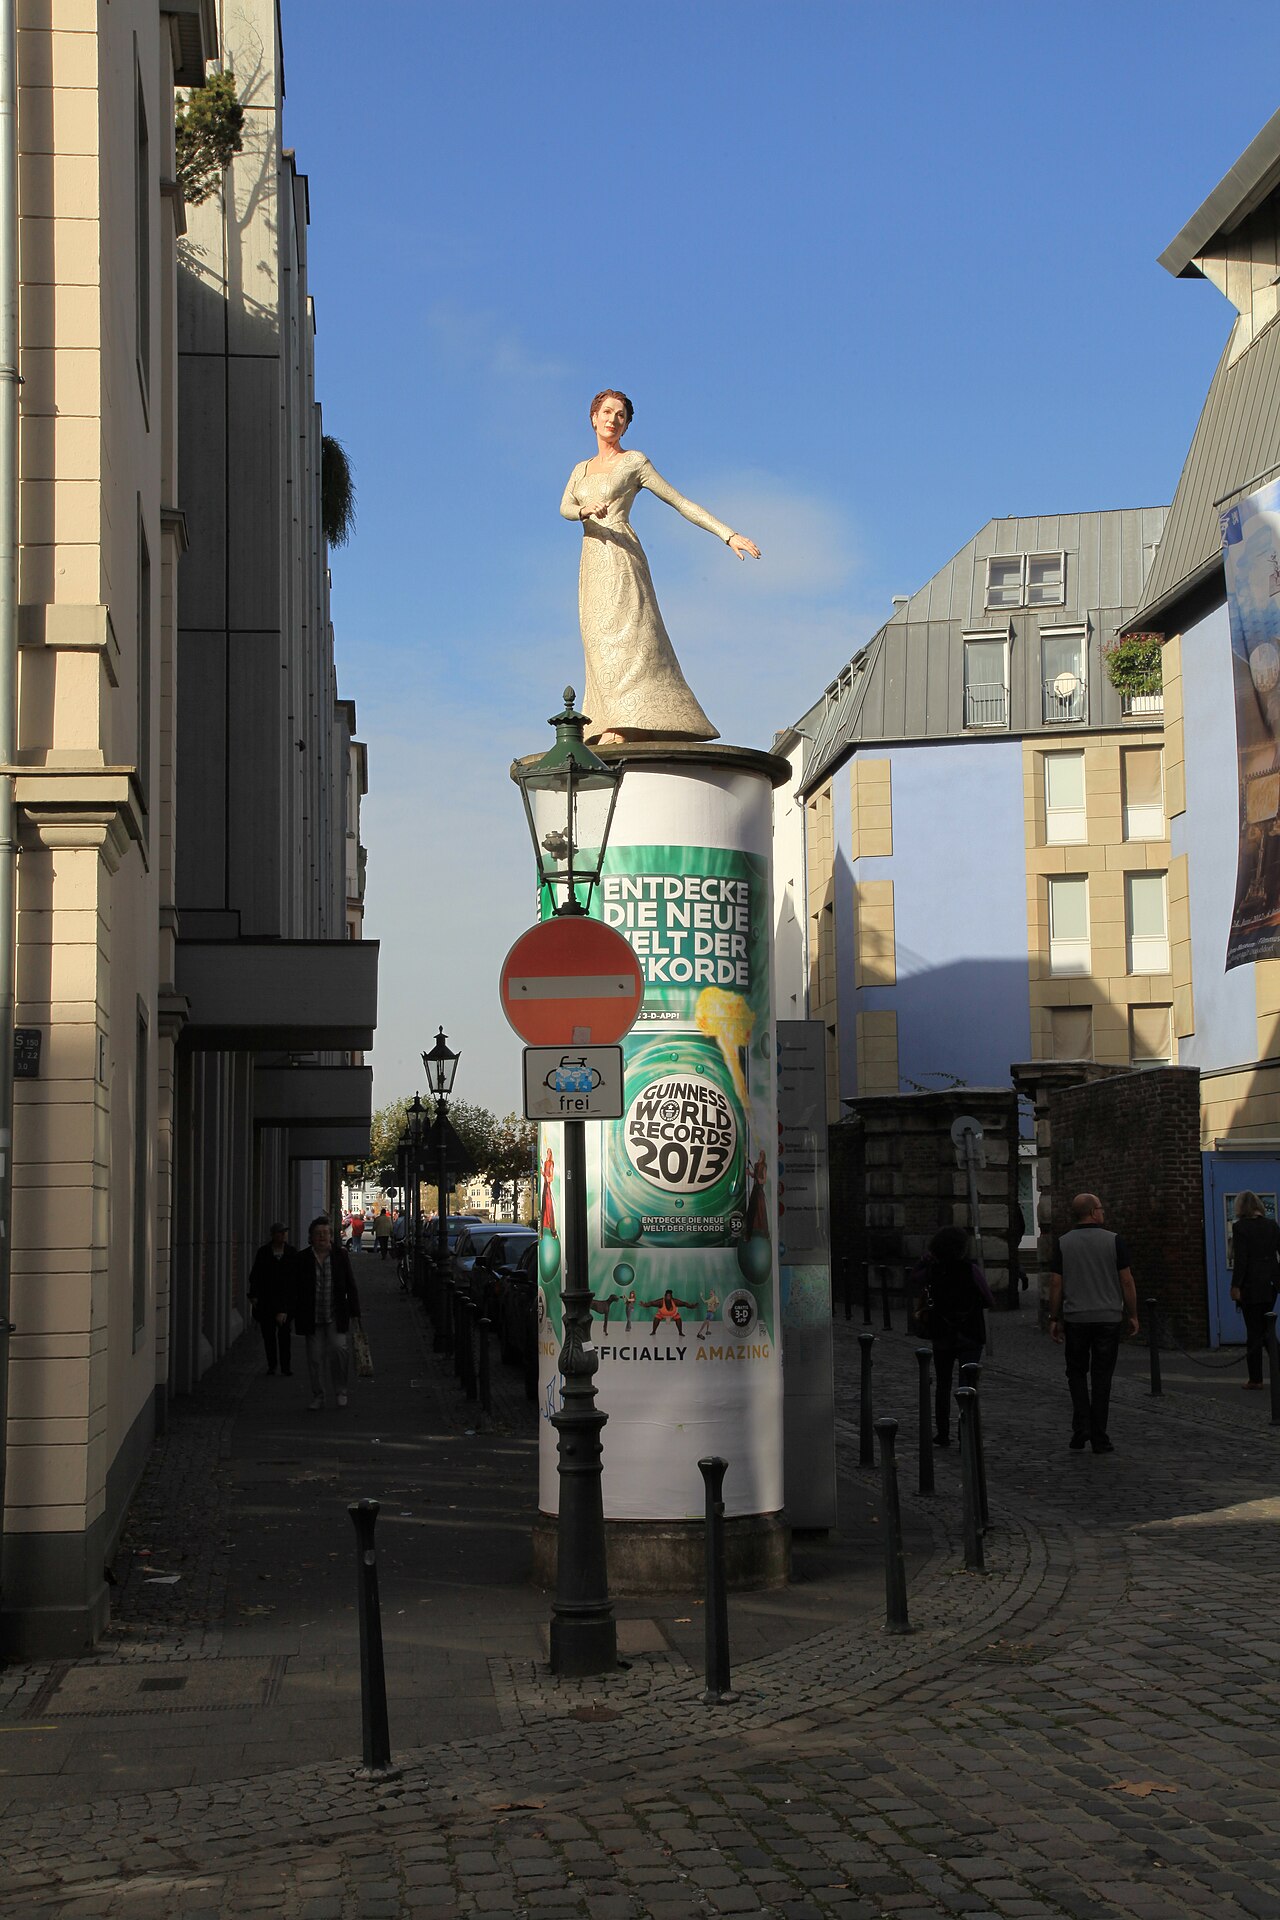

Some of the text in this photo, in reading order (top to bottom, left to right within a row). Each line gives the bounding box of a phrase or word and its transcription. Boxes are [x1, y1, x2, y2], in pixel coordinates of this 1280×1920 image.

[604, 877, 749, 905] ENTDECKE
[604, 902, 749, 932] DIE NEUE
[694, 932, 747, 959] DER
[642, 1012, 680, 1020] 3-D-APP!
[15, 1035, 24, 1046] S
[560, 1095, 589, 1111] frei
[643, 1083, 727, 1110] GUINNESS
[629, 1121, 732, 1147] RECORDS
[630, 1137, 729, 1184] 2013
[641, 1216, 724, 1224] ENTDECKE DIE NEUE
[735, 1310, 749, 1318] 3-D
[594, 1344, 769, 1361] FICIALLY AMAZING
